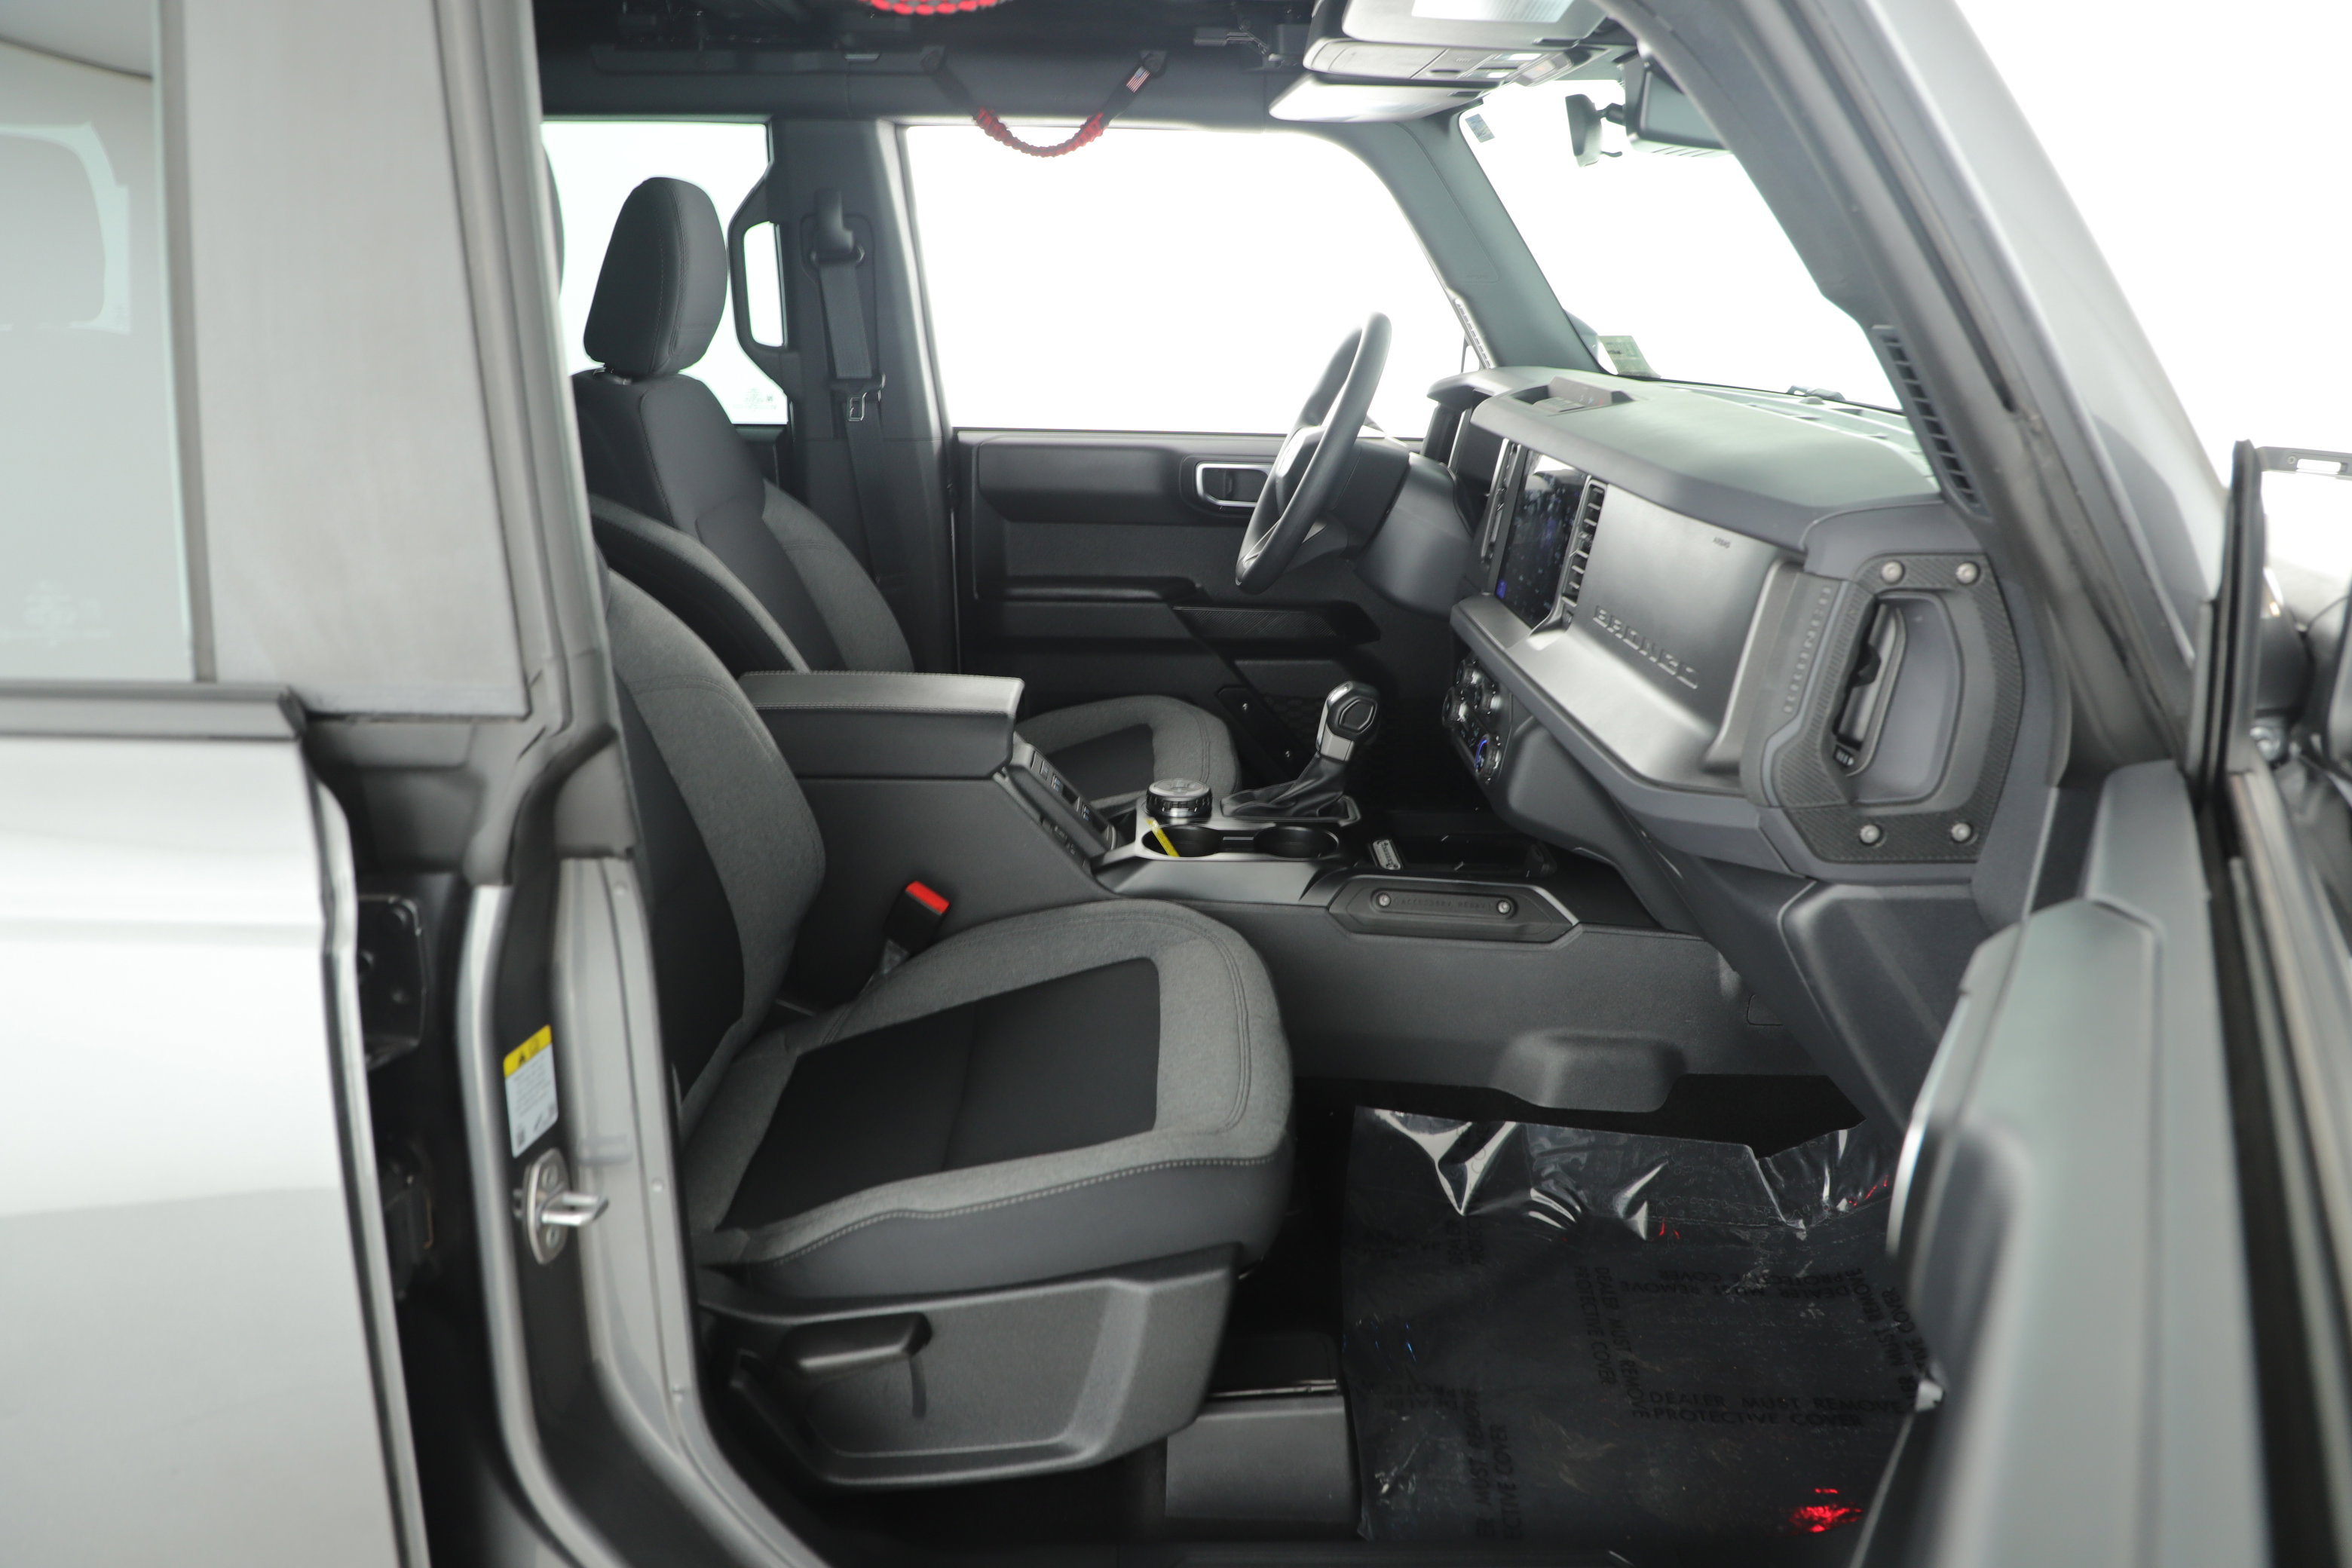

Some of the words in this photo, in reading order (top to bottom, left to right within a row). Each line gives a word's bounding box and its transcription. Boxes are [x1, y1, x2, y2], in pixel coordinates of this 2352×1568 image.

[1593, 605, 1698, 689] BRONCO
[1594, 1267, 1619, 1309] DEALER
[1620, 1280, 1701, 1294] REMOVE
[1658, 1269, 1721, 1282] COVER
[1780, 1285, 1849, 1299] DEALER
[1845, 1268, 1885, 1321] REMOVE
[1574, 1266, 1604, 1337] PROTECTIVE
[1591, 1342, 1616, 1385] COVER
[1882, 1287, 1915, 1334] COVER
[1609, 1318, 1631, 1352] MUST
[1874, 1328, 1906, 1366] MUST
[1619, 1360, 1651, 1418] REMOVE
[1649, 1392, 1725, 1407] DEALER
[1741, 1397, 1800, 1410] MUST
[1812, 1398, 1906, 1415] REMOVE
[1461, 1388, 1486, 1450] REMOVE
[1654, 1408, 1779, 1425] PROTECTIVE
[1790, 1413, 1864, 1428] COVER
[1489, 1424, 1514, 1476] COVER
[1468, 1457, 1491, 1506] MUST
